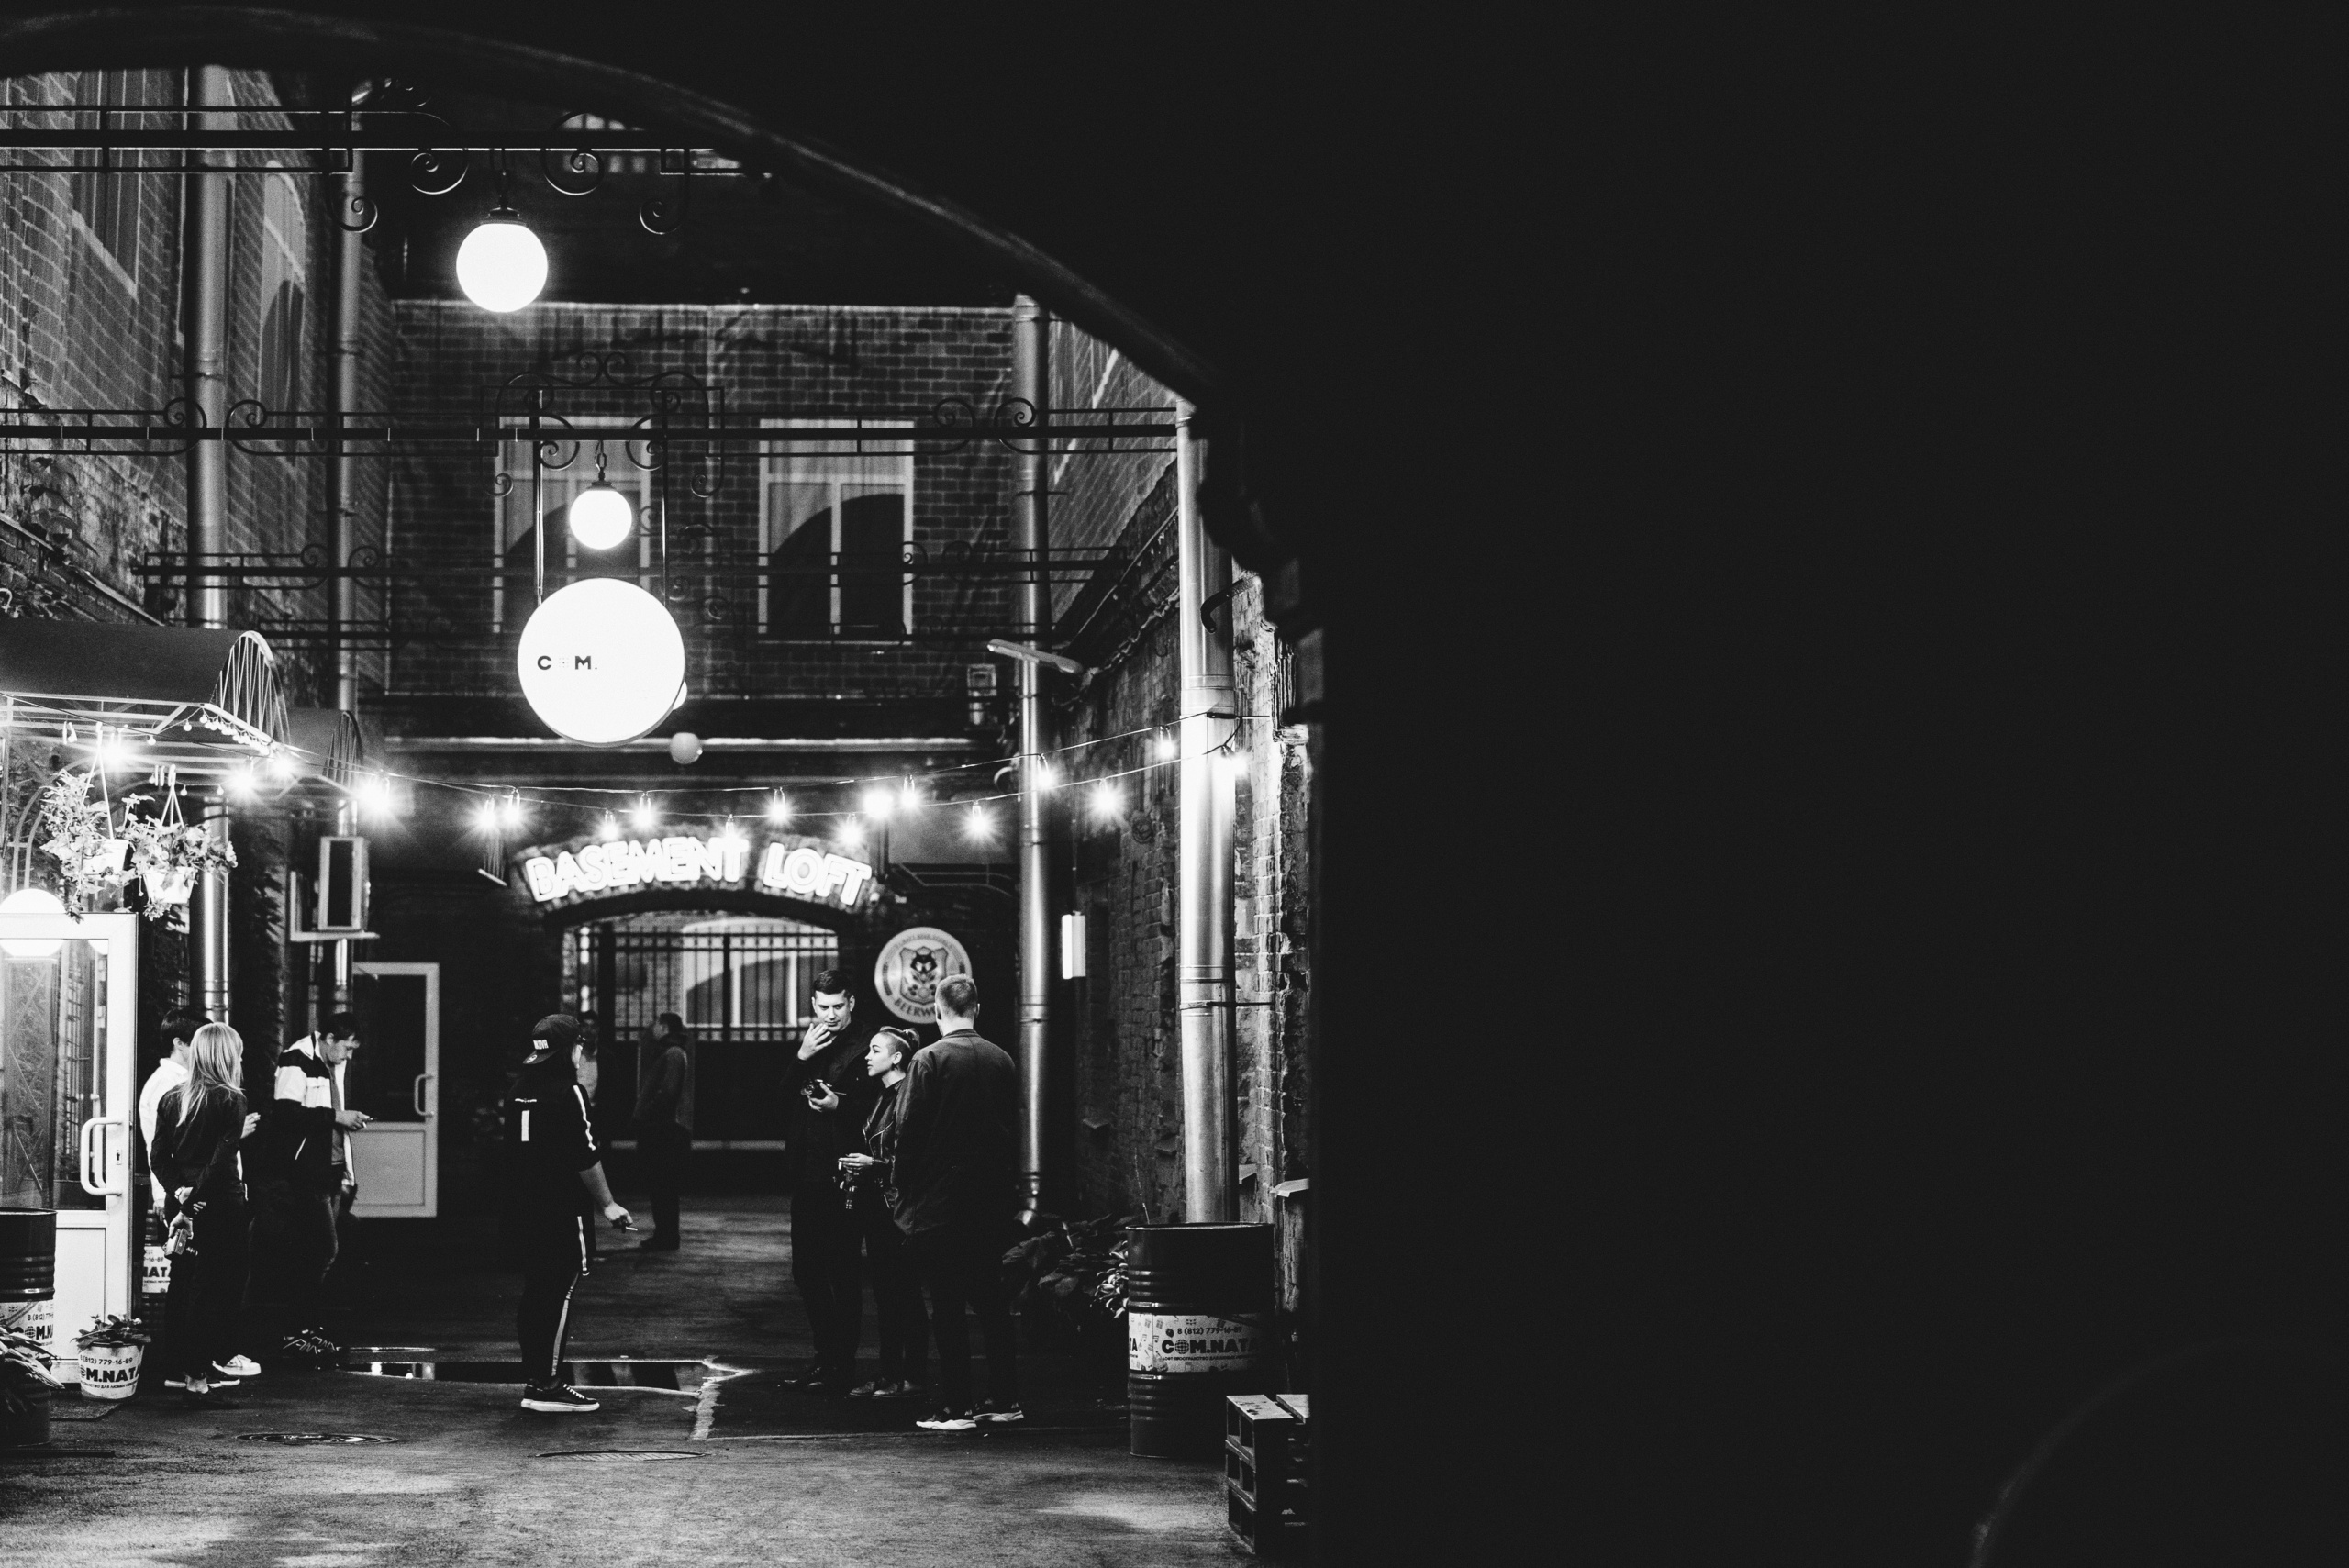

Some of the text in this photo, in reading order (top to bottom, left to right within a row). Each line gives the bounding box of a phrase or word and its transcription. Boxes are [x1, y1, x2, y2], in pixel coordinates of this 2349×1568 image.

[526, 836, 872, 906] BASEMENT LOFT
[1184, 1327, 1205, 1335] (812)
[98, 1356, 134, 1366] 779-16-89
